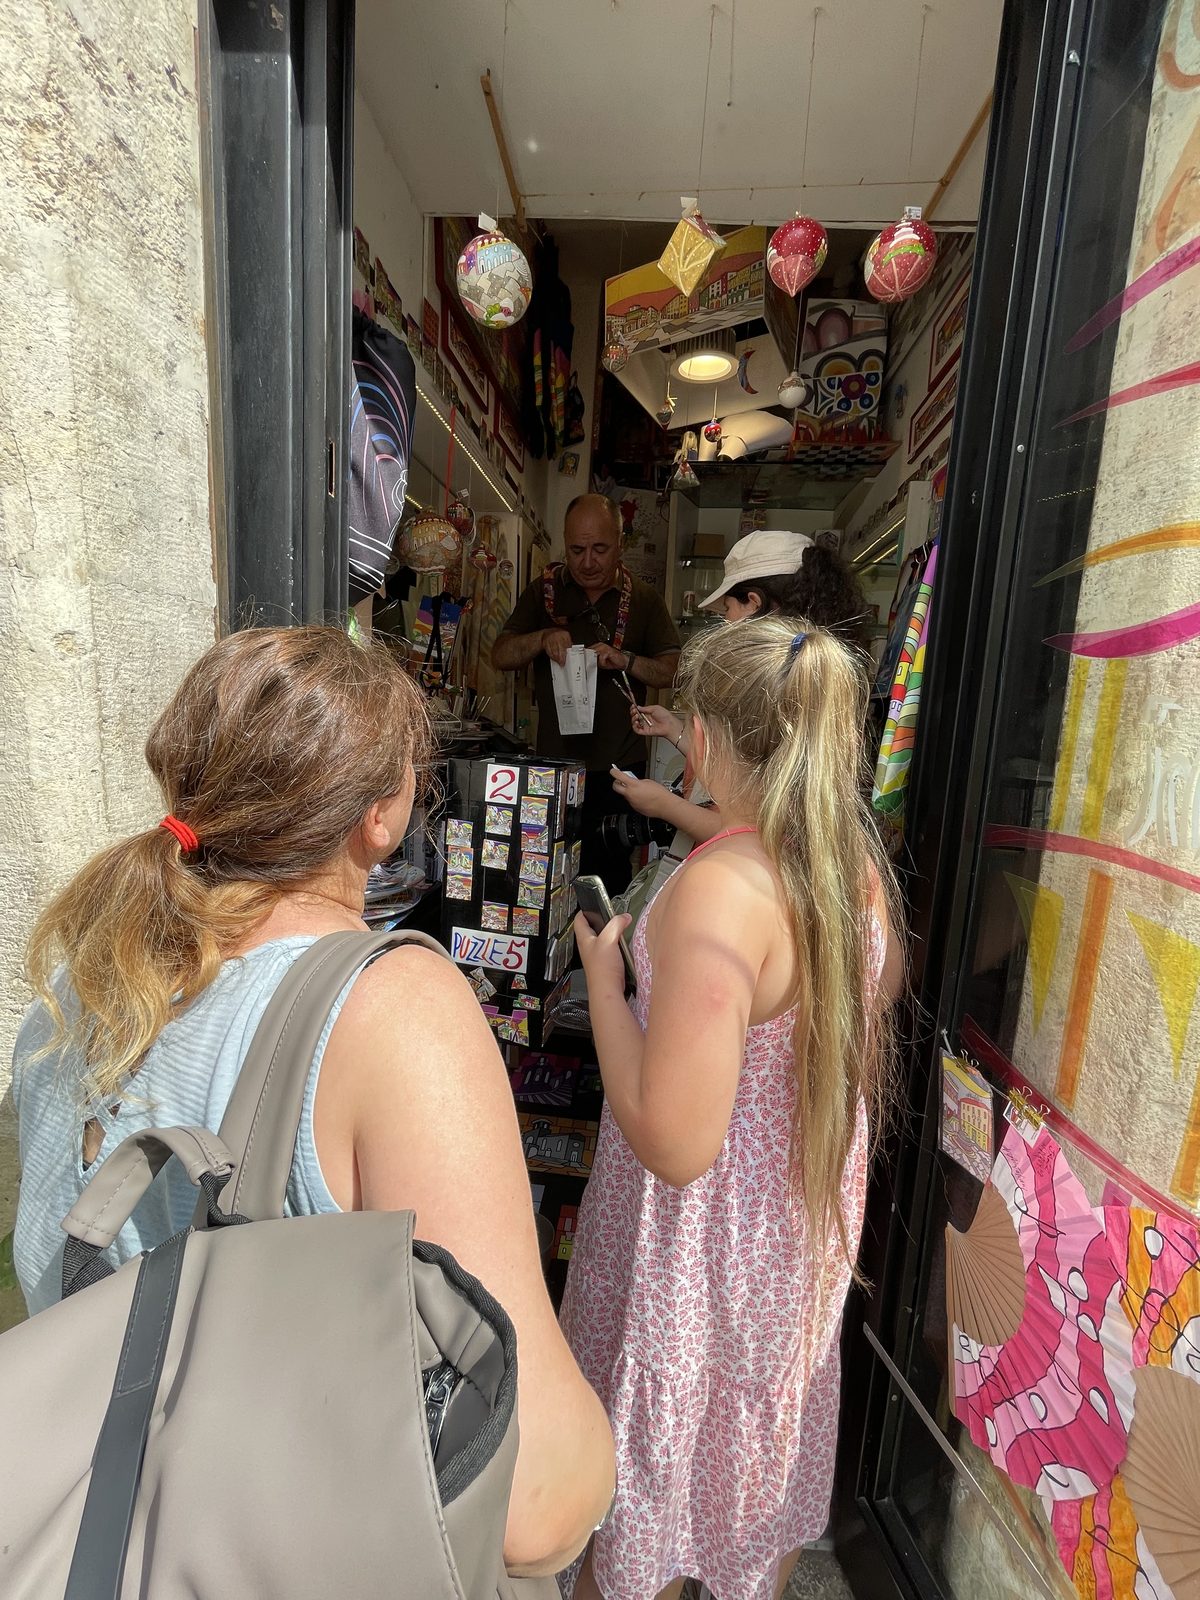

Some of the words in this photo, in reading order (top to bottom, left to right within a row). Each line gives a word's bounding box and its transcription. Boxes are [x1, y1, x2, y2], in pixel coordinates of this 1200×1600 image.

[489, 769, 516, 801] 2
[453, 932, 507, 966] PUZZLE
[502, 939, 526, 970] 5
